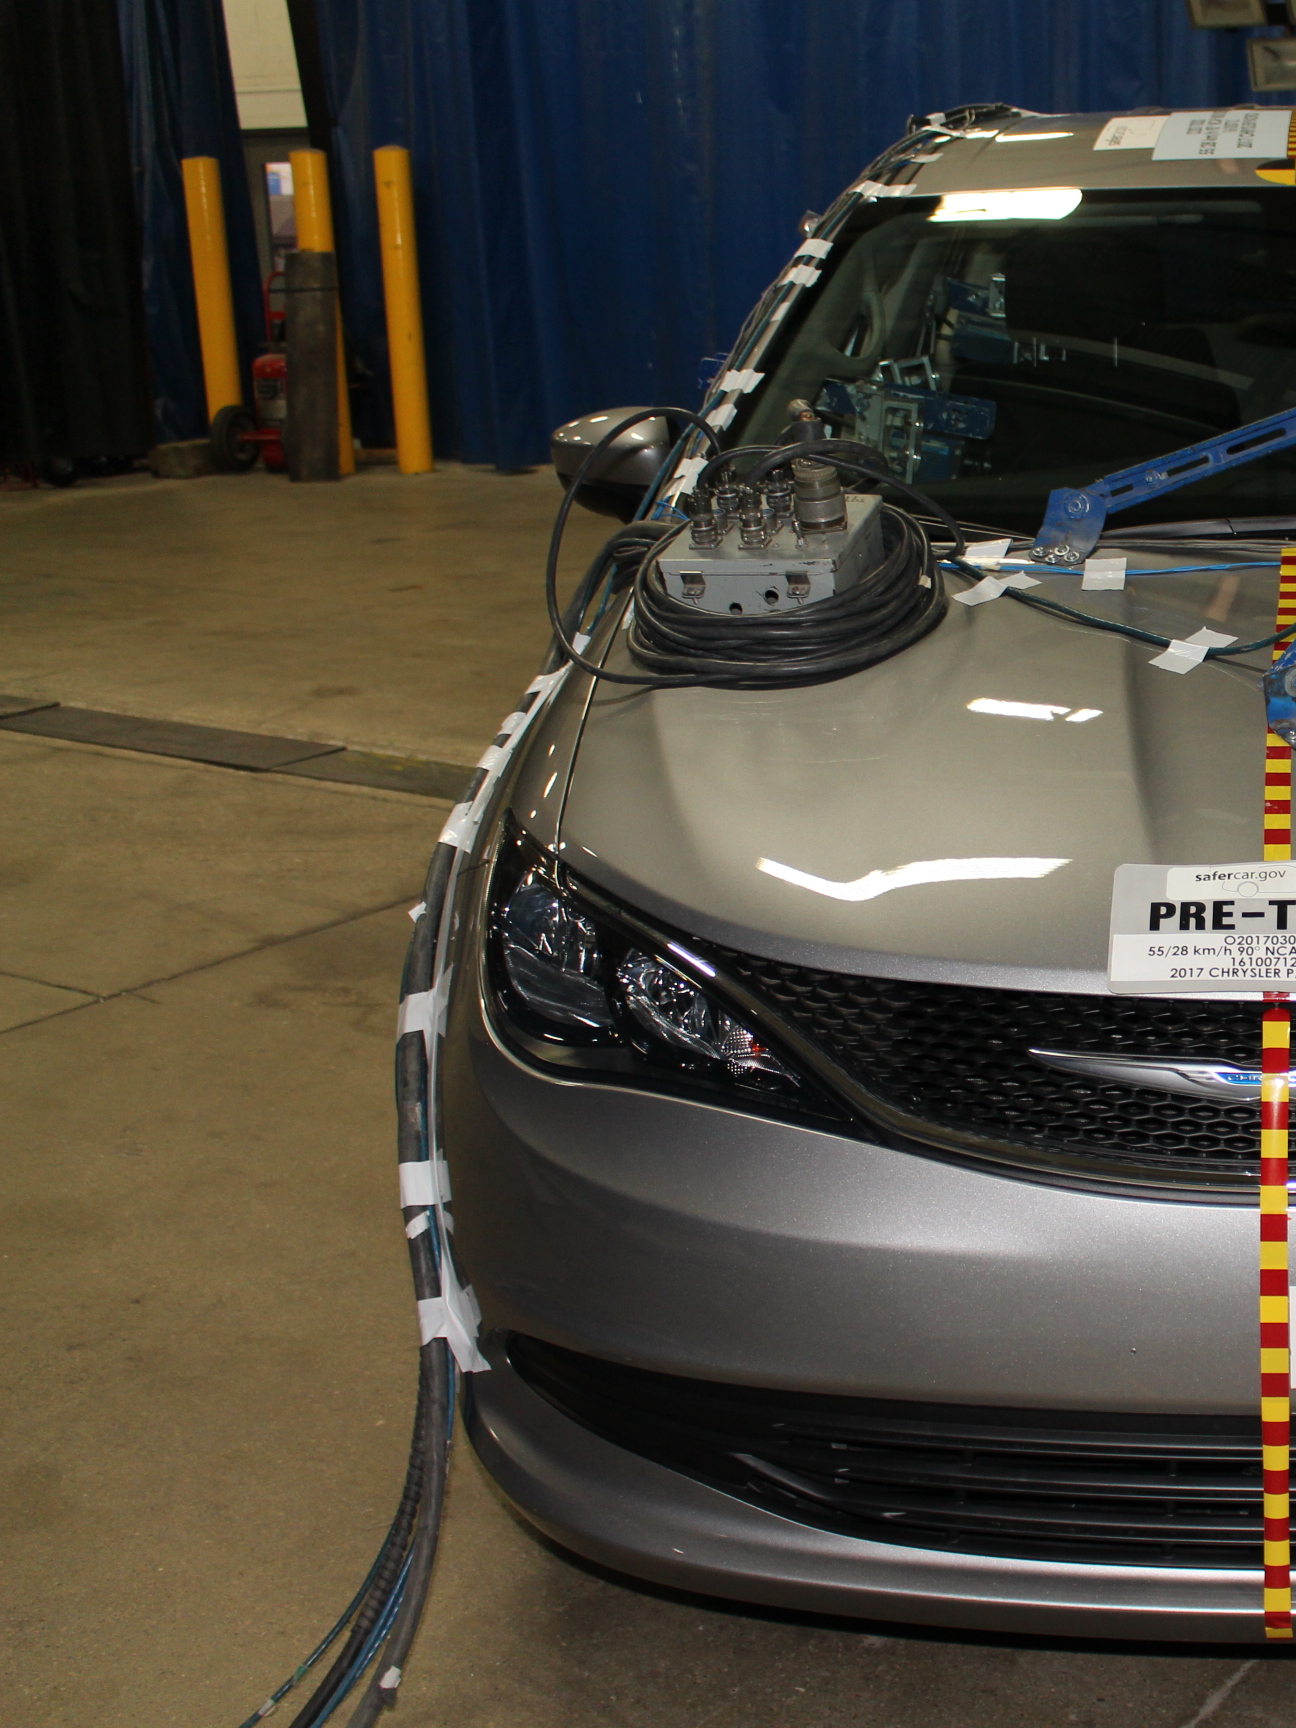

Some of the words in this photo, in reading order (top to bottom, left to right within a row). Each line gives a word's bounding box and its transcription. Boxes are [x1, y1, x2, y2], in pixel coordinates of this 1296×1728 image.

[1195, 868, 1287, 884] safercar.gov
[1148, 945, 1189, 957] 55/28
[1193, 945, 1233, 957] km/h
[1170, 968, 1204, 979] 2017
[1208, 968, 1282, 979] CHRYSLER
